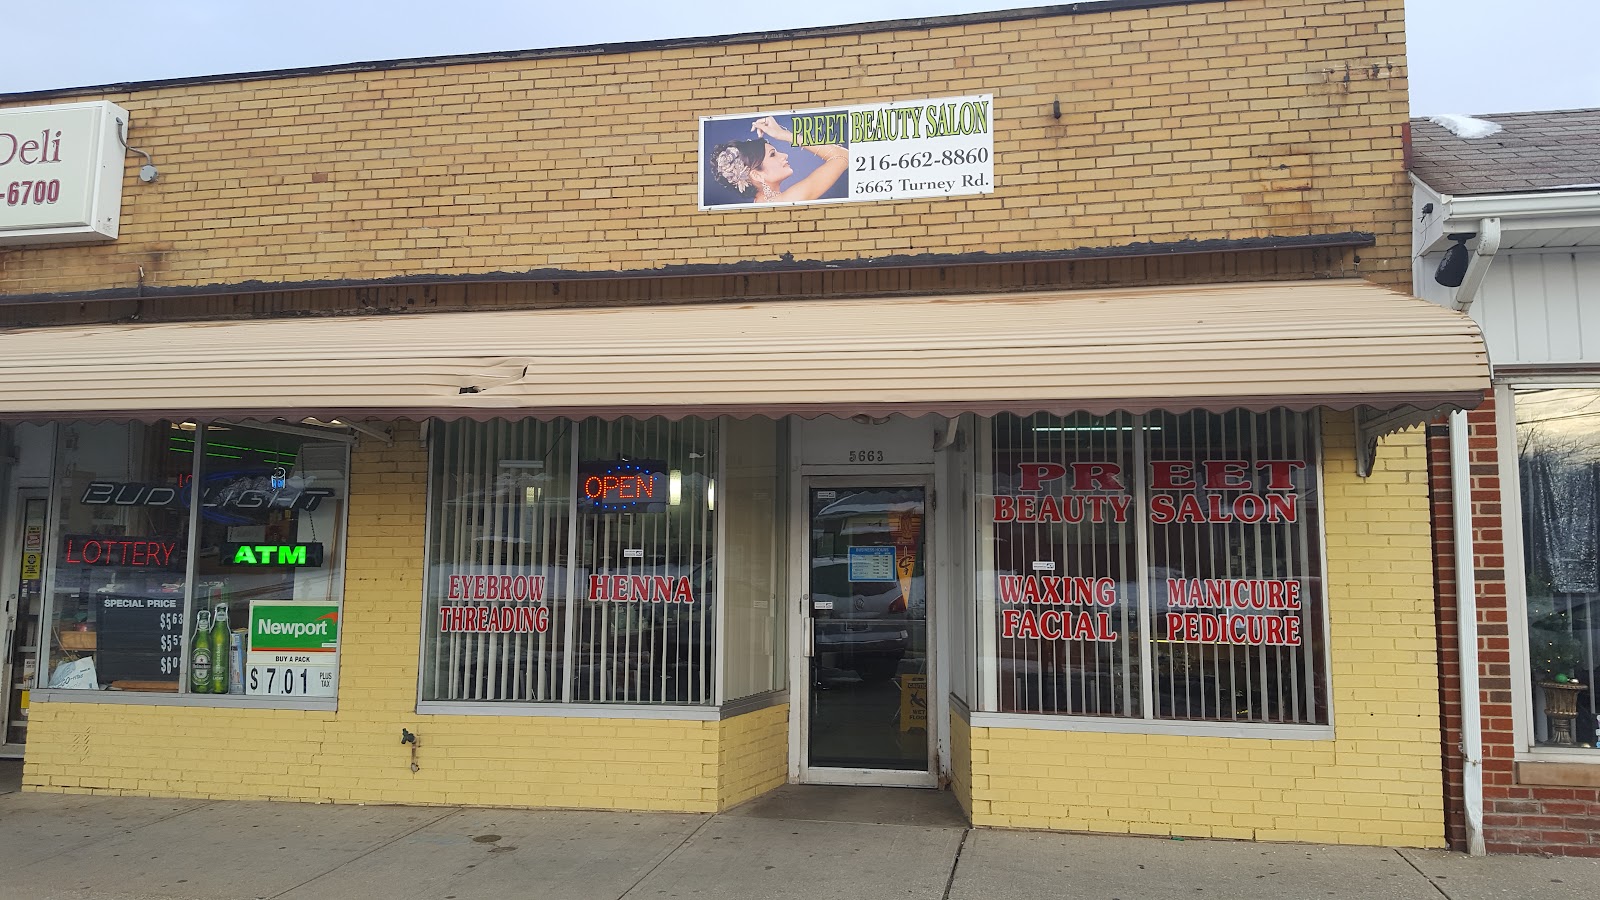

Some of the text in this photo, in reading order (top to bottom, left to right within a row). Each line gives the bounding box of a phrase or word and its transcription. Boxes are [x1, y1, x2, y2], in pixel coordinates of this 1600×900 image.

[791, 101, 989, 147] PREET BEAUTY SALON
[855, 147, 989, 172] 216-662-8860
[855, 173, 989, 194] 5663 Turney Rd.
[849, 450, 884, 462] 5663
[82, 483, 329, 508] BUD LIGHT
[585, 476, 653, 498] OPEN
[993, 493, 1298, 524] BEAUTY SALON
[66, 539, 176, 565] LOTTERY
[233, 545, 306, 564] ATM
[447, 575, 545, 602] EYEBROW
[588, 574, 695, 603] HENNA
[1000, 575, 1116, 607] WAXING
[1166, 578, 1301, 610] MANICURE
[104, 599, 176, 608] SPECIAL PRICE
[258, 618, 327, 638] Newport
[440, 605, 549, 633] THREADING
[1002, 609, 1117, 642] FACIAL
[1166, 613, 1301, 645] PEDICURE
[161, 656, 182, 674] $60
[320, 671, 332, 680] PLUS
[321, 680, 330, 688] TAX
